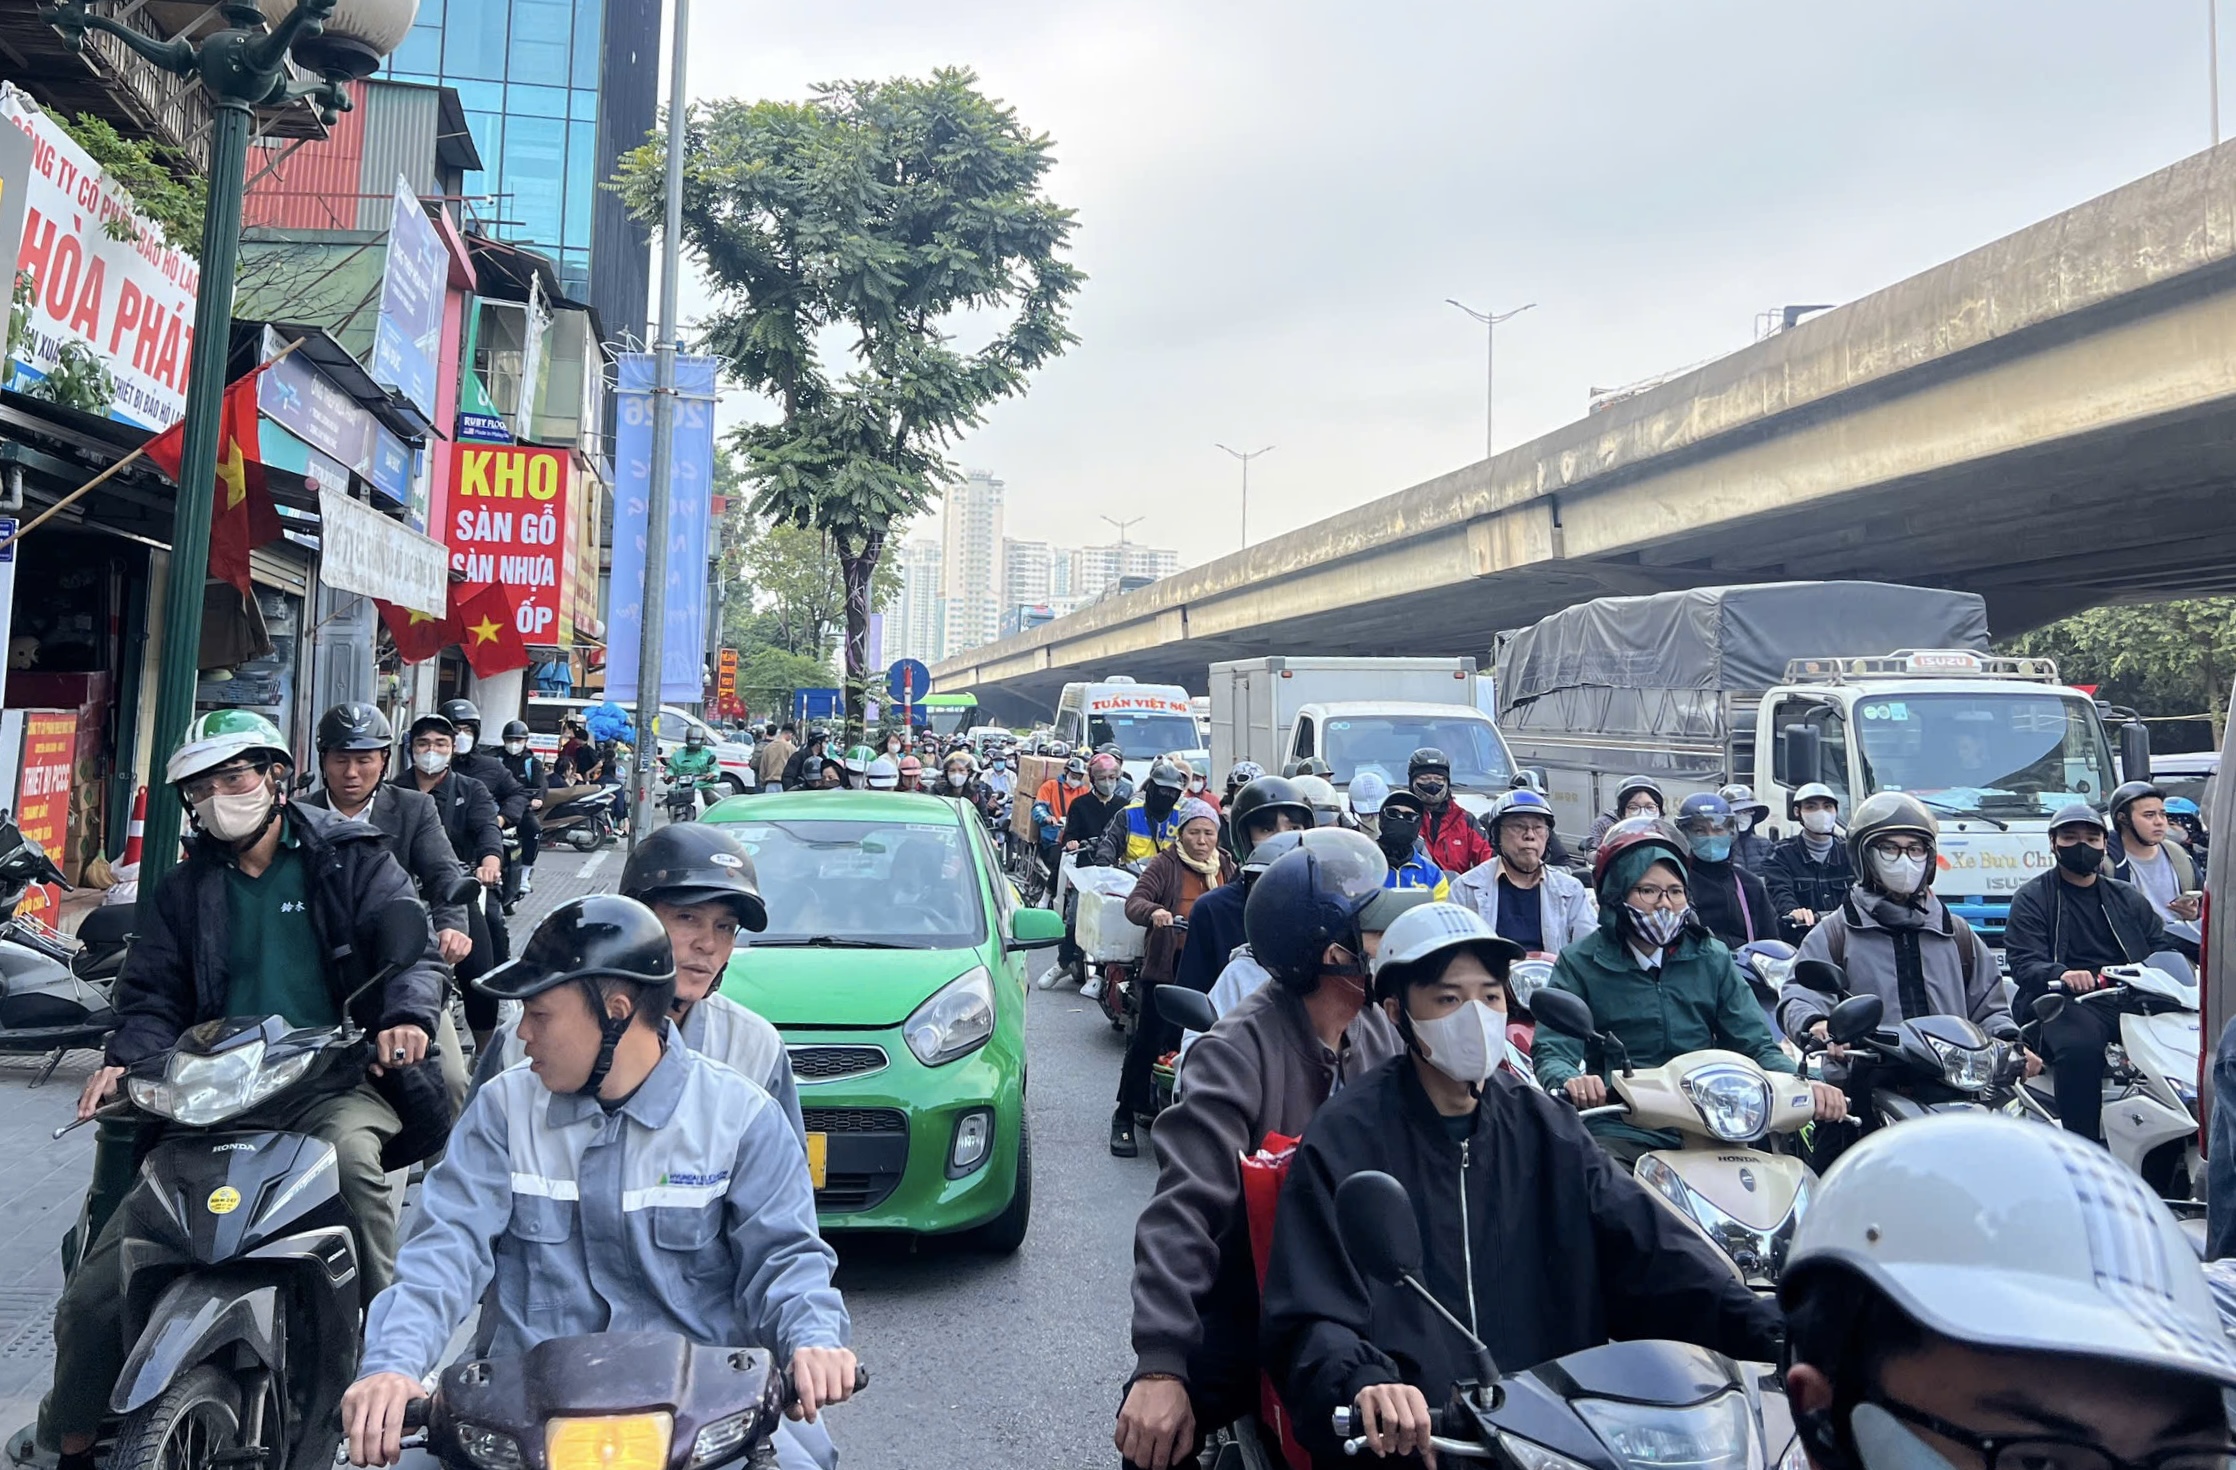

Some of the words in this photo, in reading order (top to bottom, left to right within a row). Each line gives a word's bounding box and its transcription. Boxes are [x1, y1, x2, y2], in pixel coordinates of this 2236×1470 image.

[57, 156, 78, 195] TY
[77, 175, 103, 214] CỔ
[162, 248, 179, 287] HỘ
[16, 205, 106, 343] HÒA
[38, 334, 64, 367] XUẤ
[134, 387, 143, 415] BỊ
[143, 388, 159, 419] BẢO
[160, 401, 171, 429] HỘ
[464, 416, 487, 427] RUBY
[460, 450, 559, 500] KHO
[455, 504, 513, 543] SÀN
[520, 503, 556, 545] GỖ
[452, 547, 494, 584] SÀN
[499, 554, 555, 592] NHỰA
[516, 596, 553, 634] ỐP
[1920, 656, 1966, 666] ISUZU
[1092, 693, 1131, 710] TUẤN
[1135, 698, 1166, 711] VIỆT
[1951, 851, 1975, 869] Xe
[1979, 851, 2017, 869] Bưu
[212, 1143, 256, 1153] HONDA
[1717, 1155, 1761, 1163] HONDA
[327, 1247, 347, 1264] HONDA
